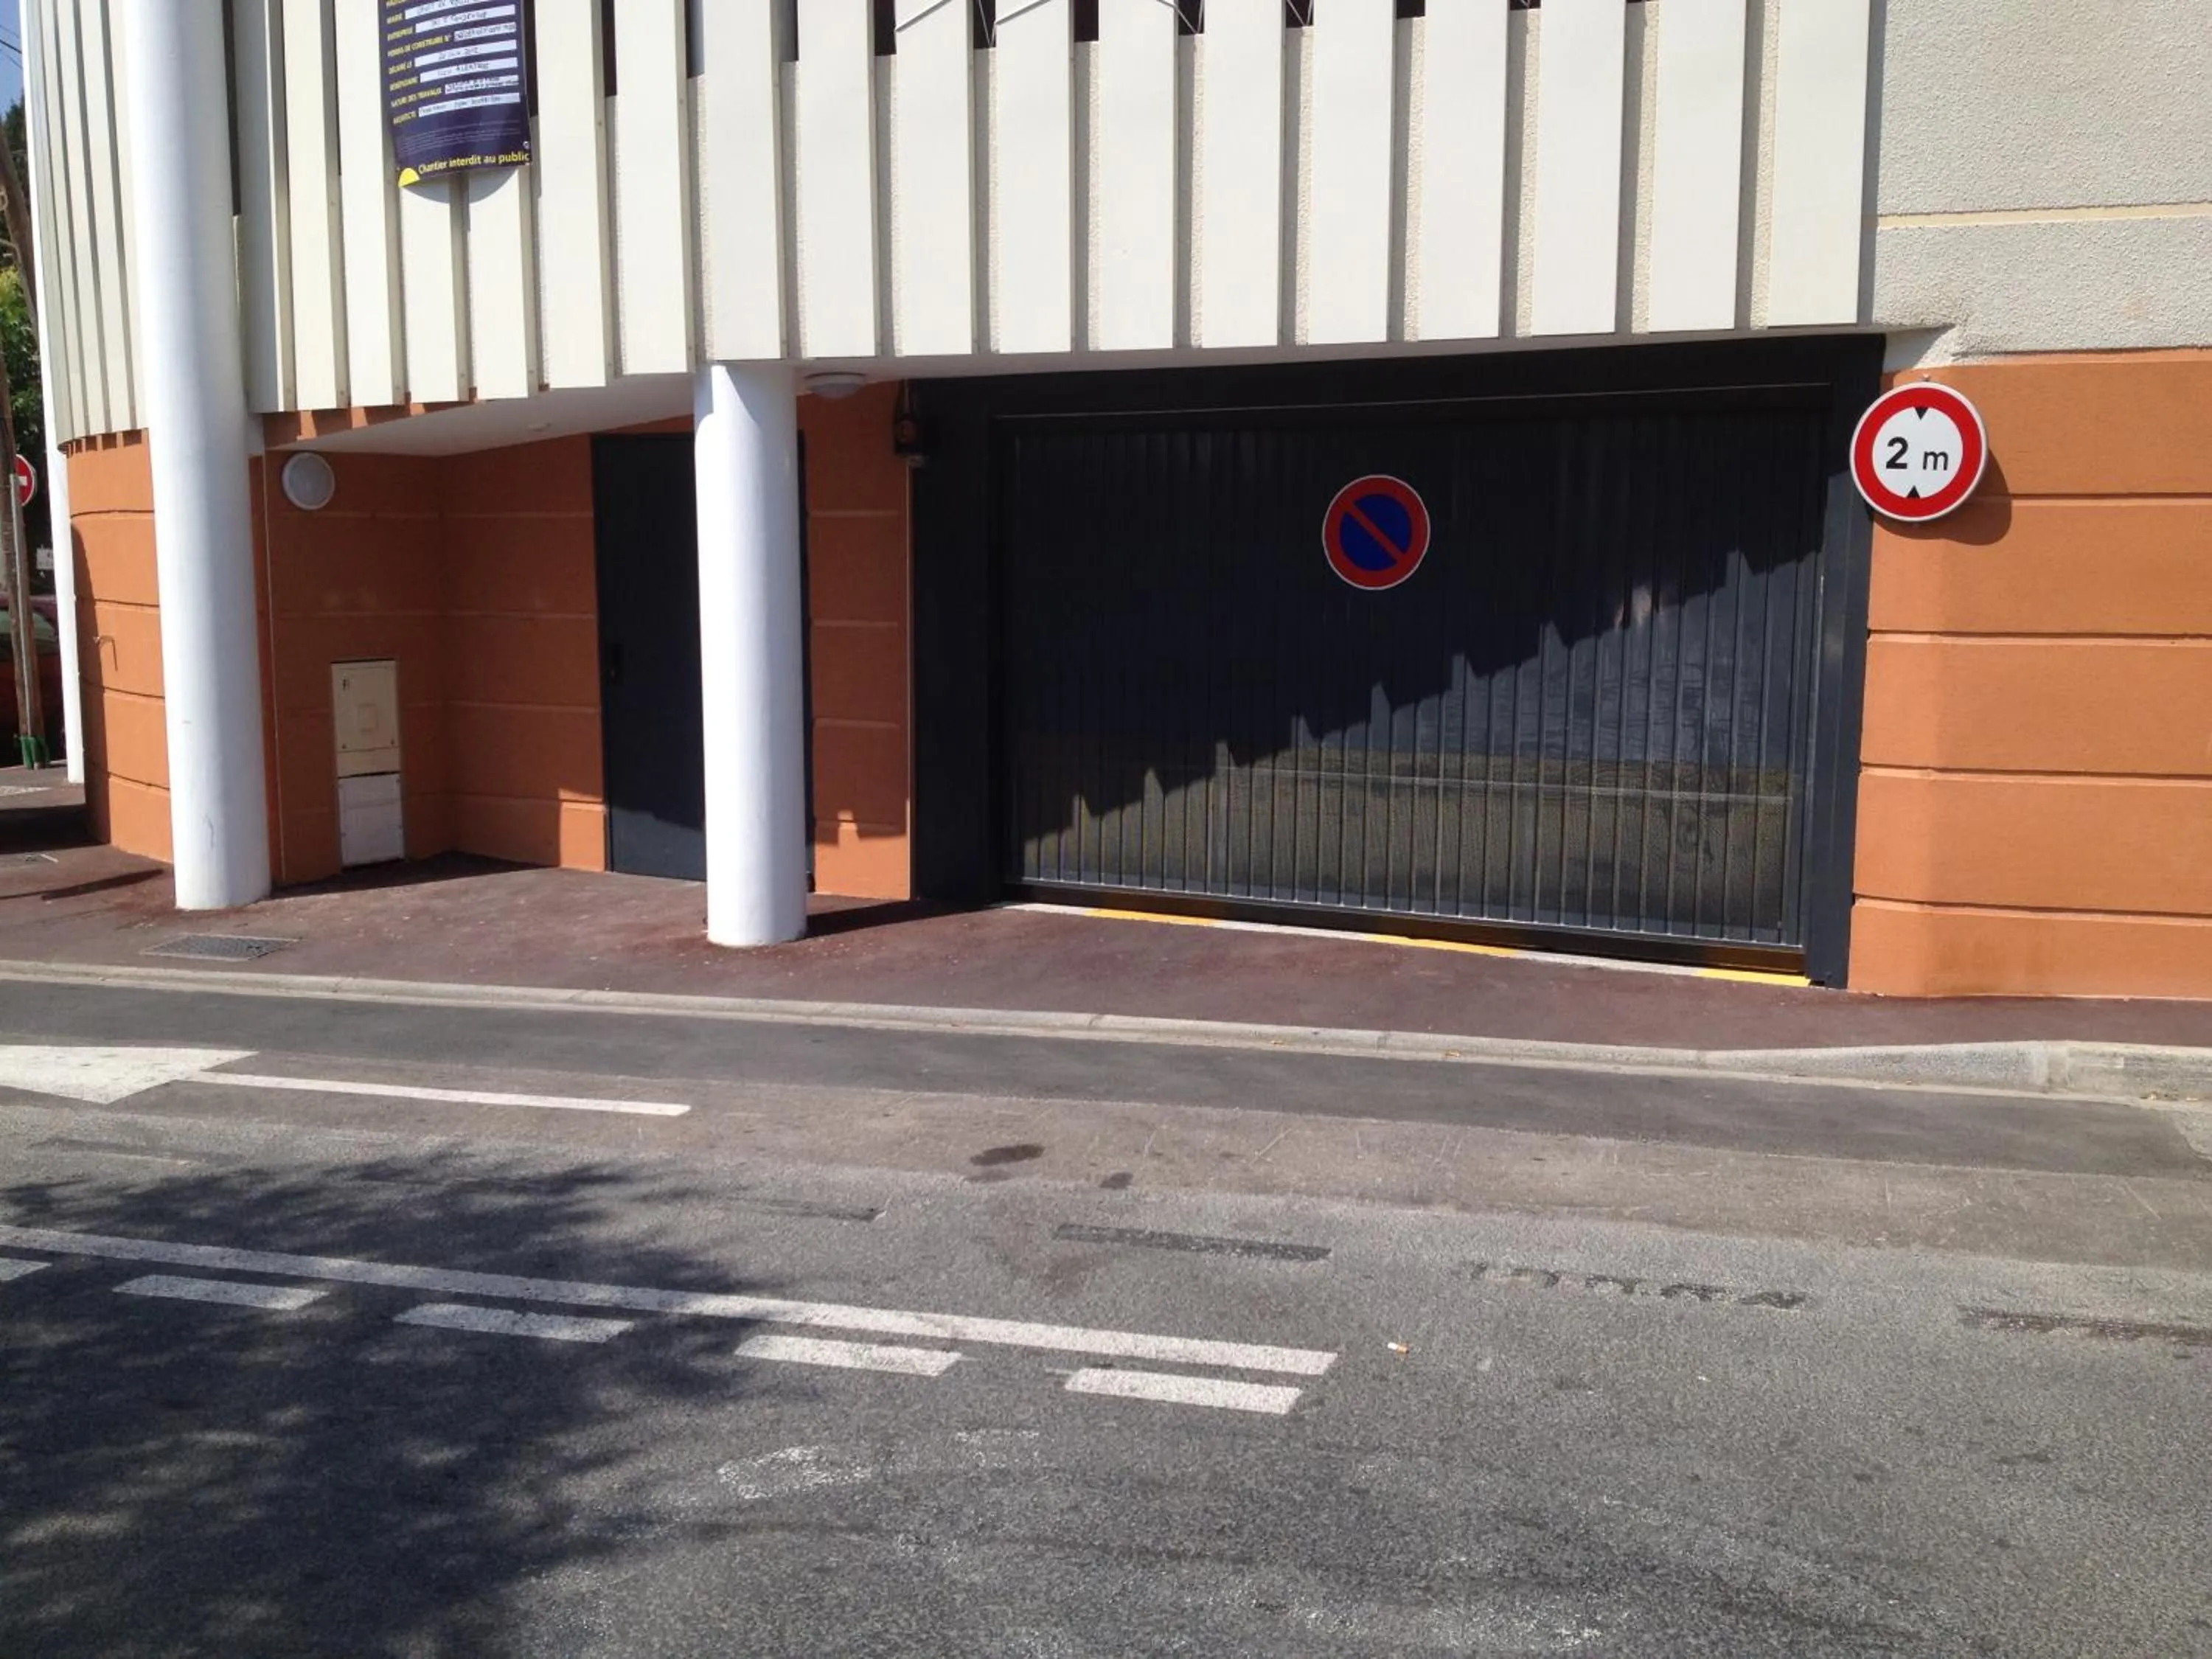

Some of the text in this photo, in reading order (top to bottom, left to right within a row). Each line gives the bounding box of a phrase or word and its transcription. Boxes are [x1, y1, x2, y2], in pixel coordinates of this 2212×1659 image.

[418, 150, 529, 174] Chantier interdit au public
[1885, 437, 1949, 470] 2 m
